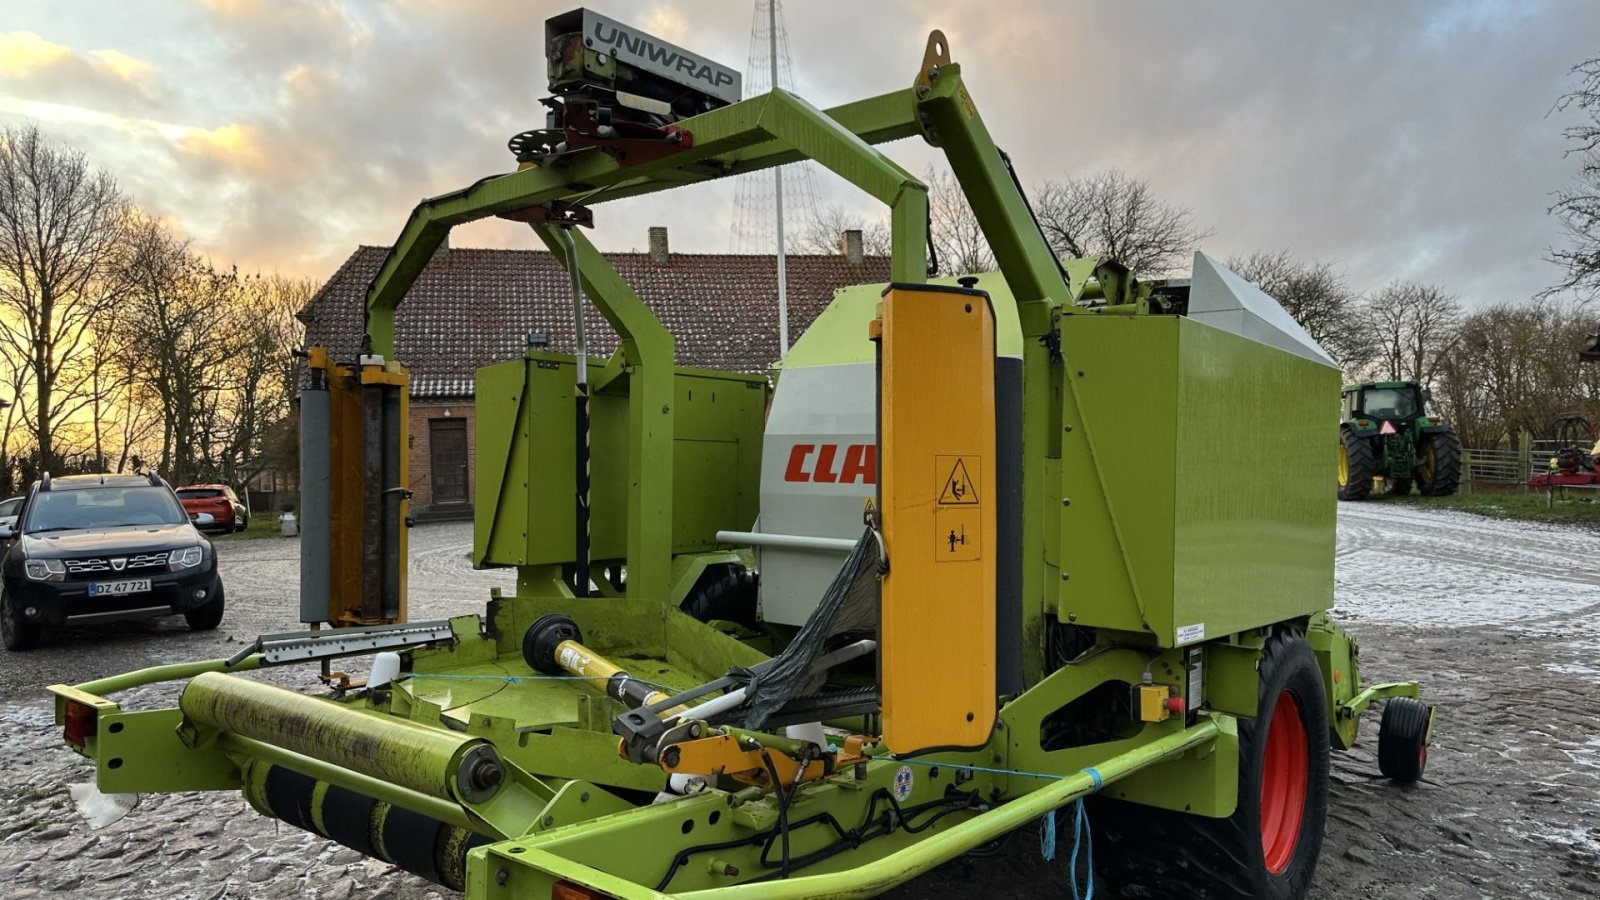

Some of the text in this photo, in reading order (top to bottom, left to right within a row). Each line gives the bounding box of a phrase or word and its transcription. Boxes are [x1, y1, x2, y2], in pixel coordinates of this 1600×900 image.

[594, 22, 734, 87] UNIWRAP
[784, 444, 876, 484] CLA
[97, 580, 149, 594] DZ 47 721
